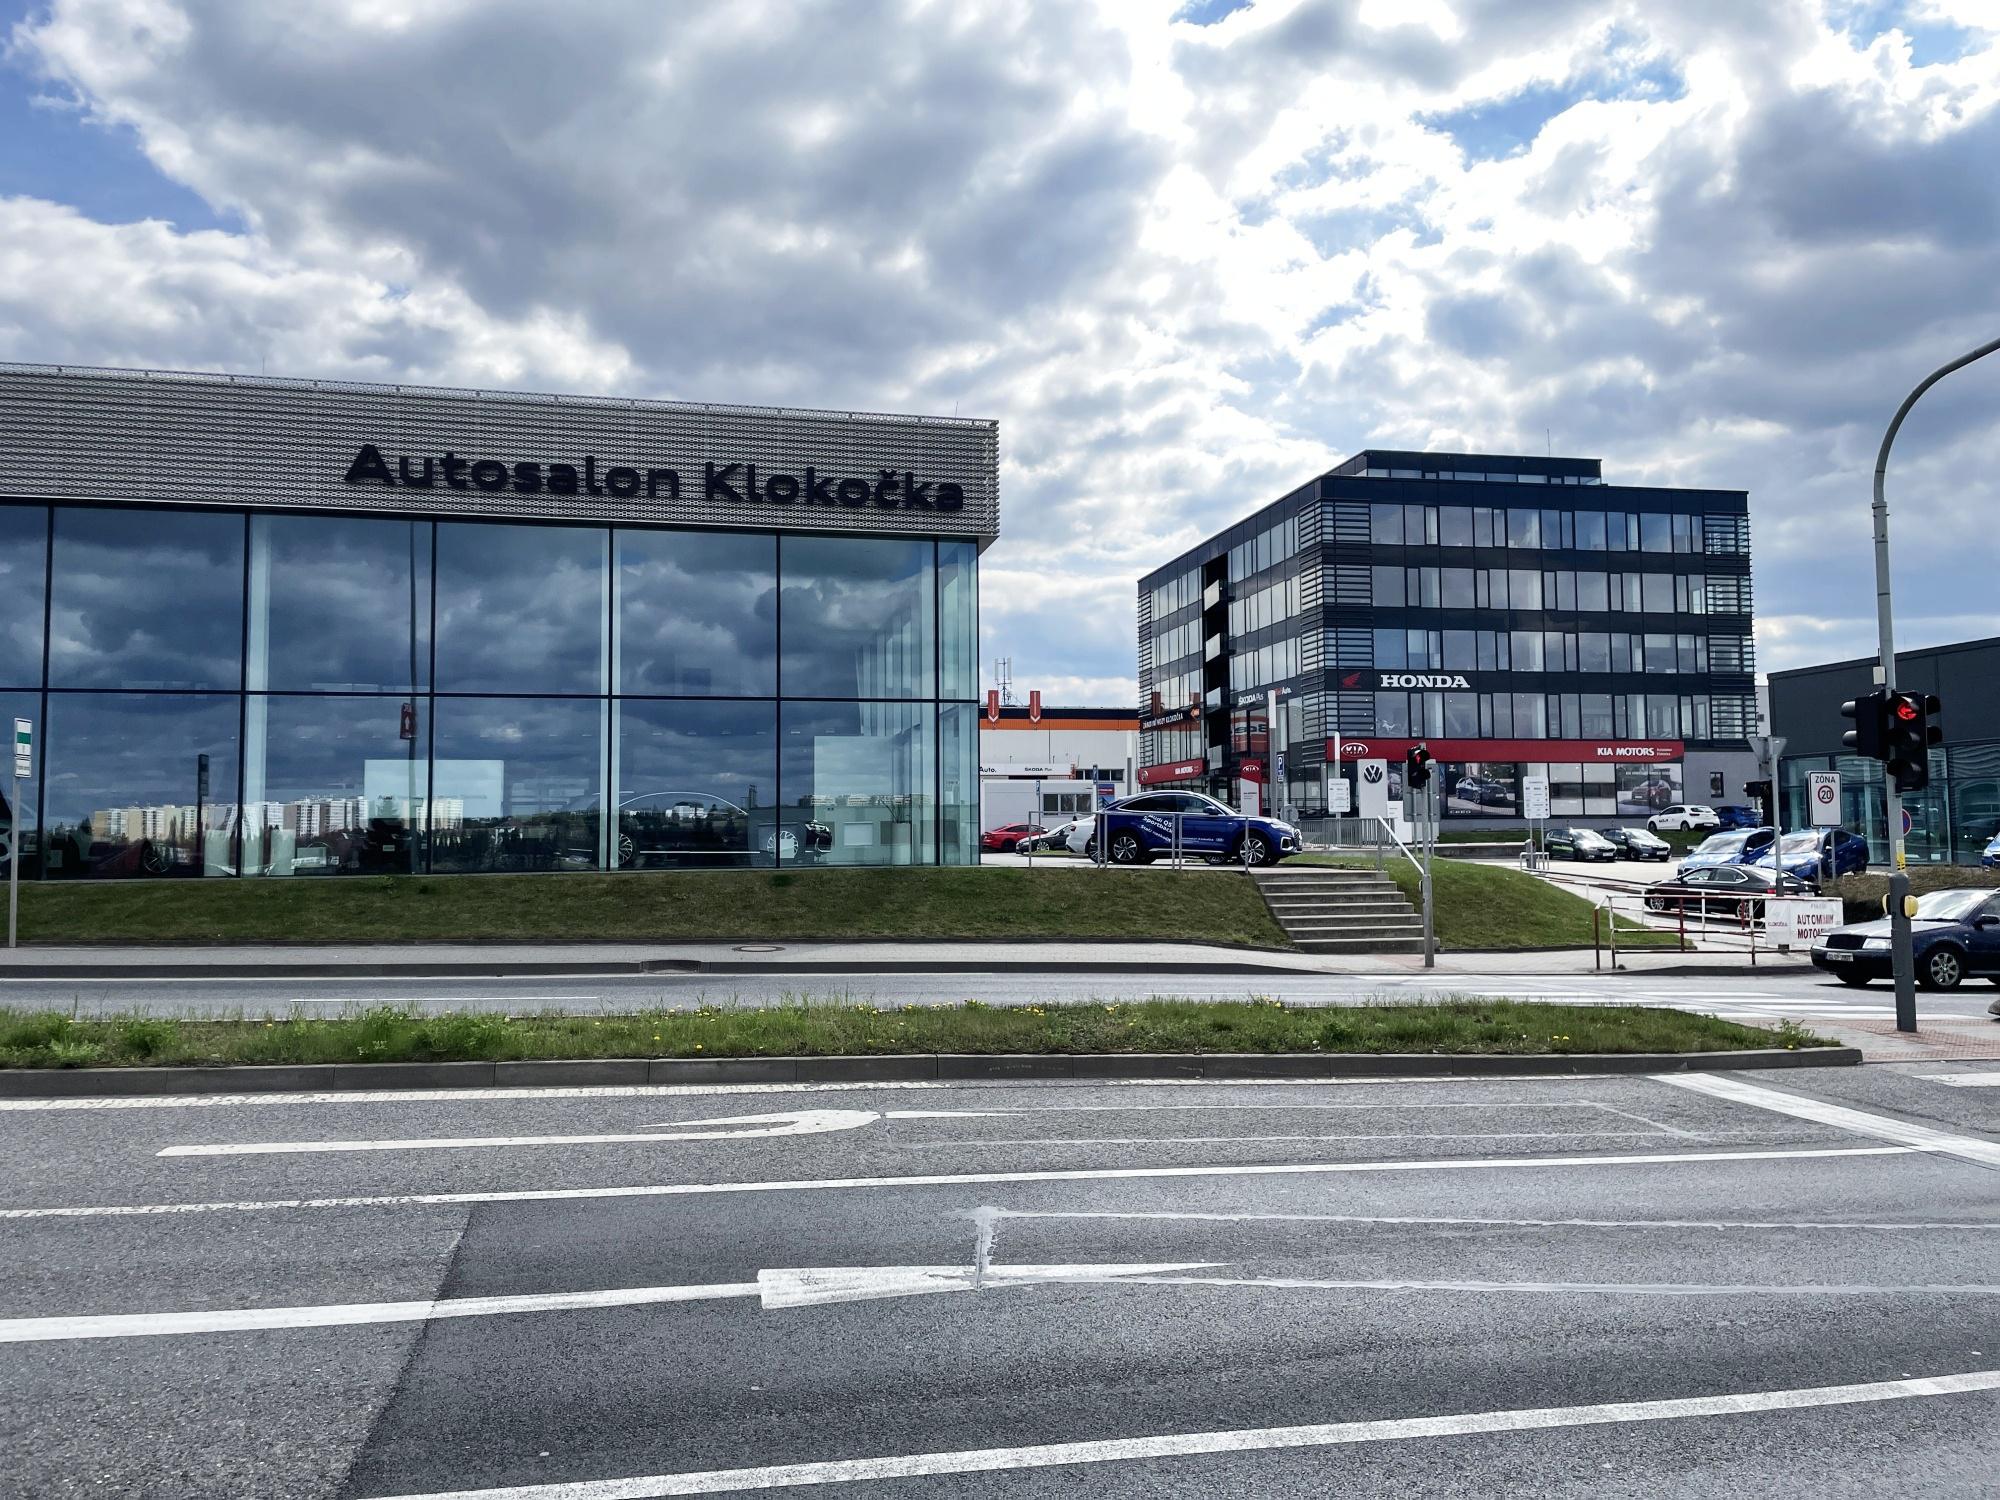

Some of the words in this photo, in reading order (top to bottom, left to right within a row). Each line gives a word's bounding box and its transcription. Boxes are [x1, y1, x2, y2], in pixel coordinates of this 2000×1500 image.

[345, 443, 681, 501] Autosalon
[703, 461, 965, 512] Klokočka
[1380, 674, 1471, 688] HONDA
[1597, 747, 1613, 756] KIA
[1616, 747, 1655, 756] MOTORS
[1821, 790, 1832, 800] 20
